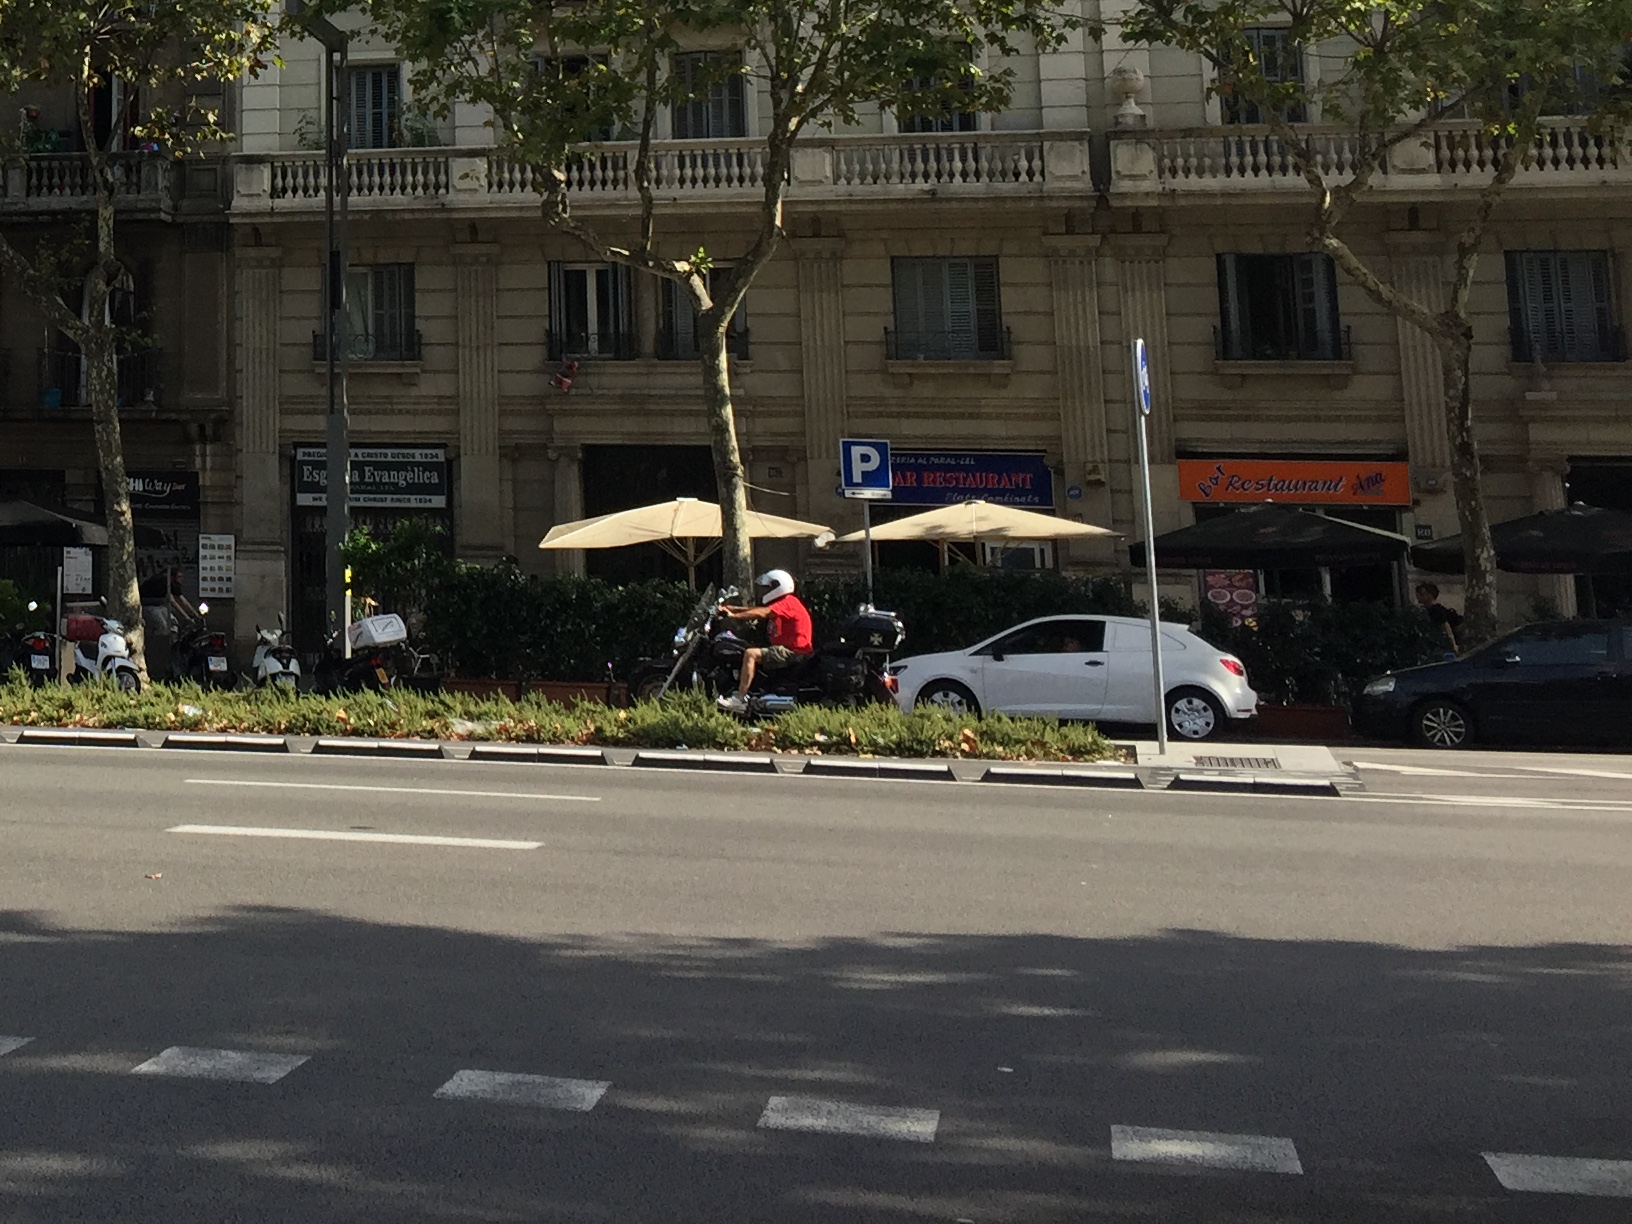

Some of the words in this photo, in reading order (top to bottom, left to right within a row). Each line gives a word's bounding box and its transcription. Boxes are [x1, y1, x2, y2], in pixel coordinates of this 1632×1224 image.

[363, 465, 440, 488] Evangèlica
[851, 445, 880, 484] P
[921, 472, 1033, 489] RESTAURANT
[1197, 464, 1225, 497] Bar
[1225, 475, 1347, 494] Restaurant
